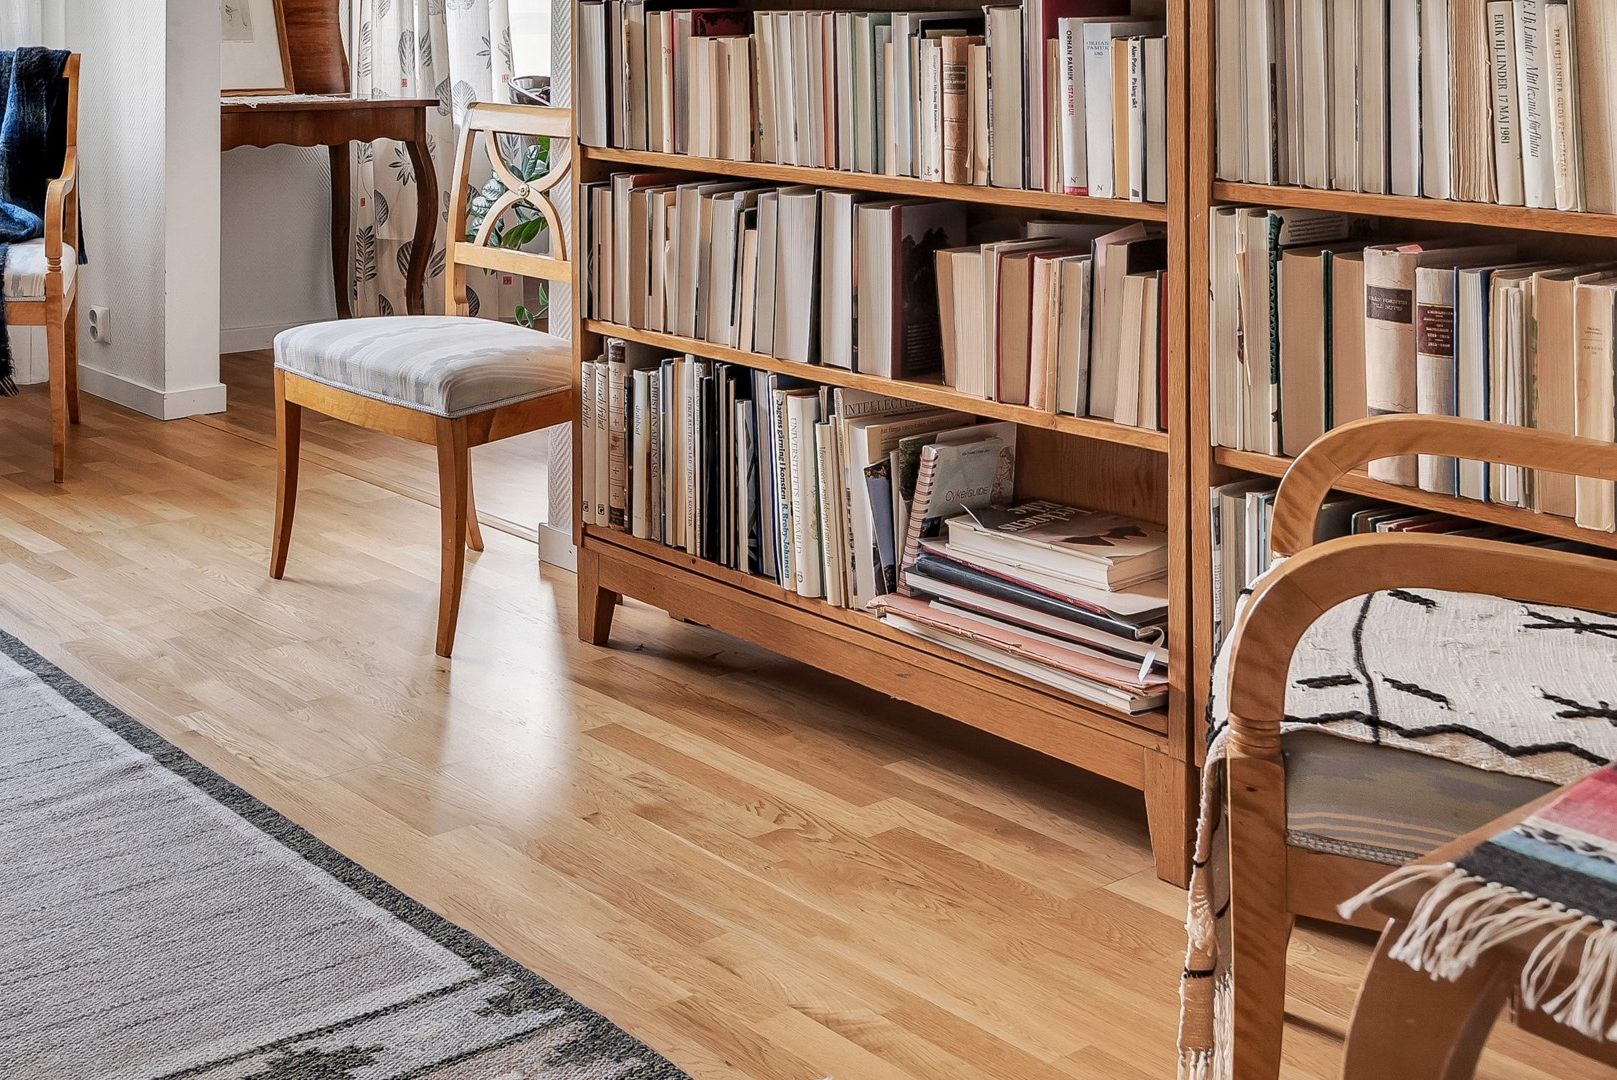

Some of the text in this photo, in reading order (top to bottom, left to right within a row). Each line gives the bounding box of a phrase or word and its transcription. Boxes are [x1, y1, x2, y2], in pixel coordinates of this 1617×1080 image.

[1494, 14, 1505, 36] ERIK
[1524, 26, 1538, 56] Linder
[1496, 54, 1508, 90] LINDER
[1525, 63, 1539, 85] Mitt
[1498, 94, 1509, 102] 17
[1497, 105, 1510, 123] MAJ
[1500, 126, 1511, 144] 1981
[1524, 119, 1541, 158] förflutna
[582, 402, 591, 428] frihet
[597, 405, 607, 431] frihet
[777, 429, 786, 461] gärning
[790, 417, 800, 497] UNIVERSITETETS
[779, 467, 787, 499] konsten
